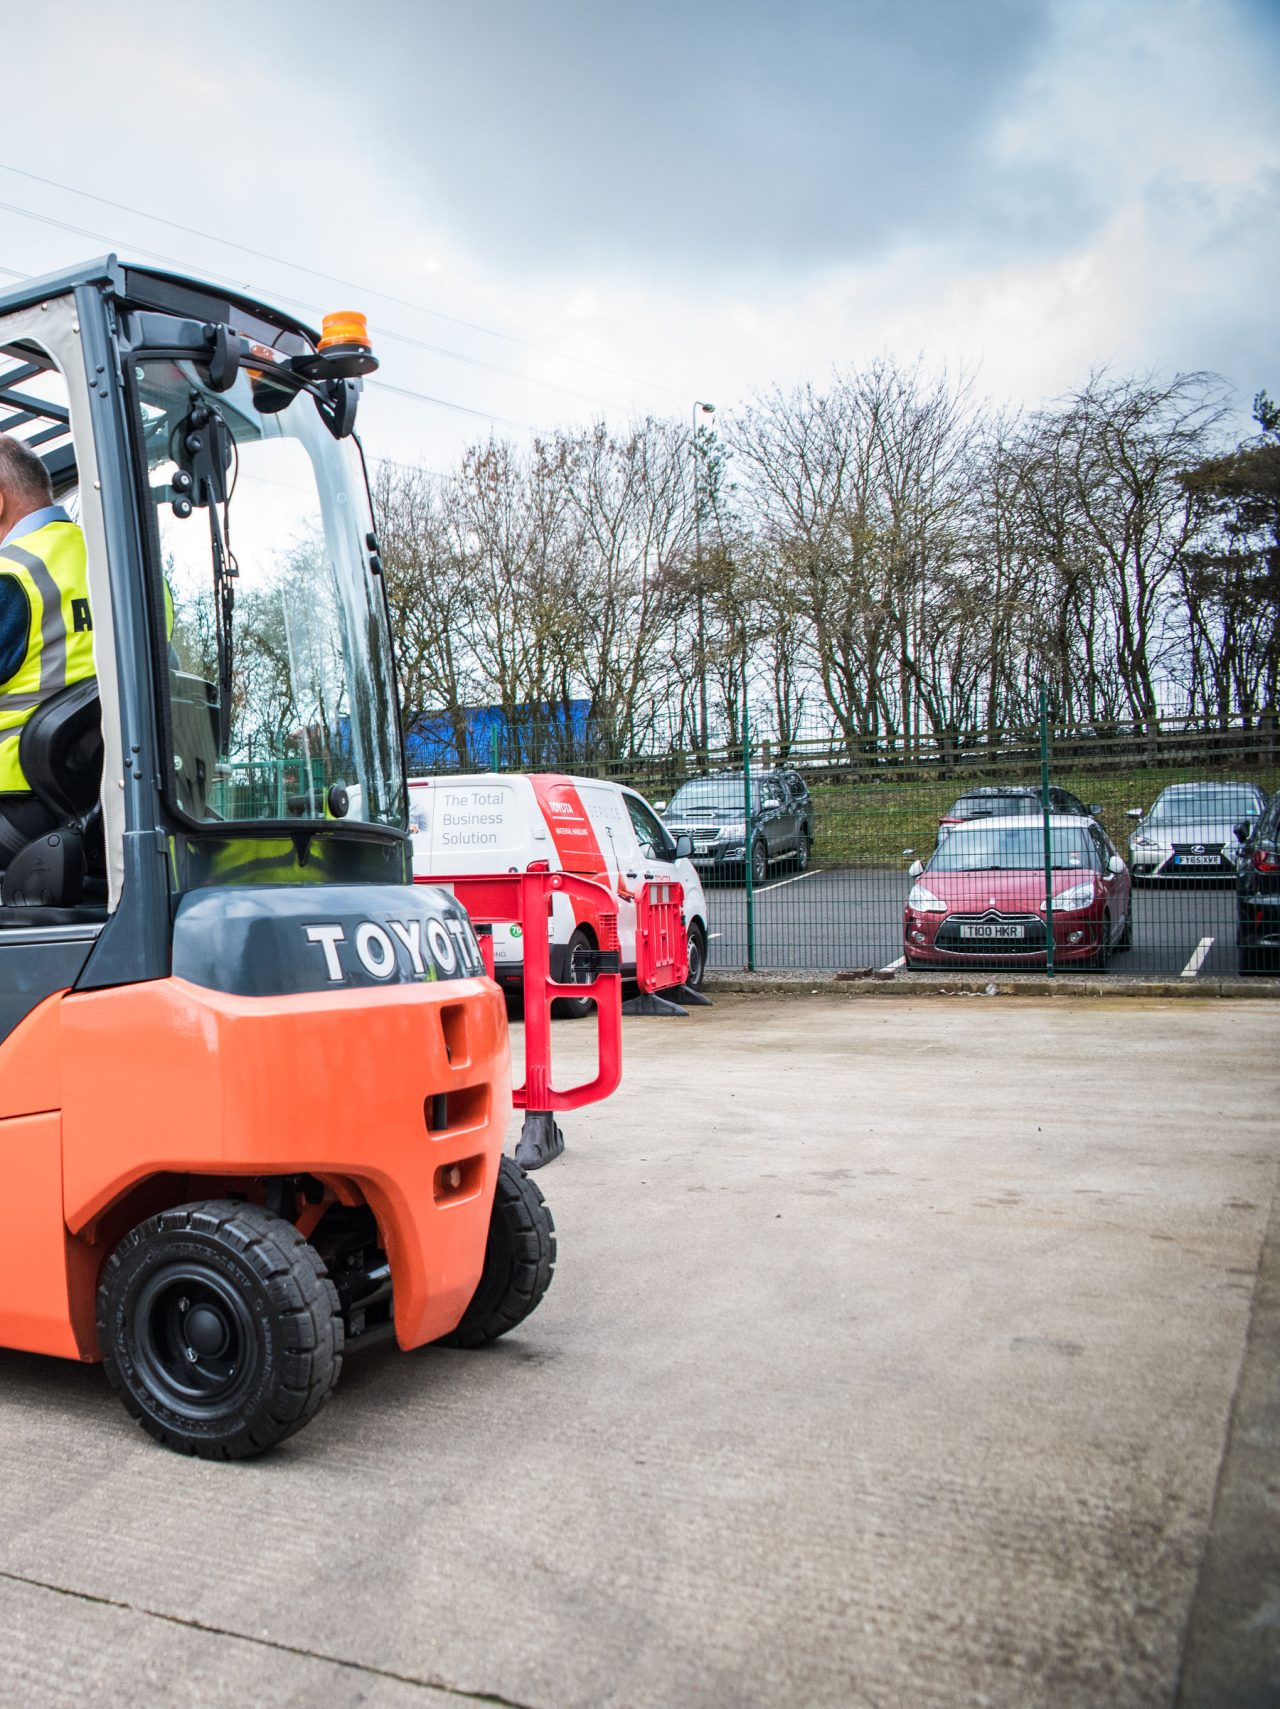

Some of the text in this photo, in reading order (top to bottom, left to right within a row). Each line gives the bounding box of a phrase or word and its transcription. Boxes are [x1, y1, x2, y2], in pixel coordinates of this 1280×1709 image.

[71, 598, 93, 633] A
[443, 791, 504, 807] The Total
[548, 801, 574, 814] TOYOTA
[443, 812, 503, 826] Business
[442, 832, 497, 845] Solution
[511, 926, 522, 934] 70
[995, 926, 1018, 937] HKR
[306, 918, 484, 981] TOYOTA
